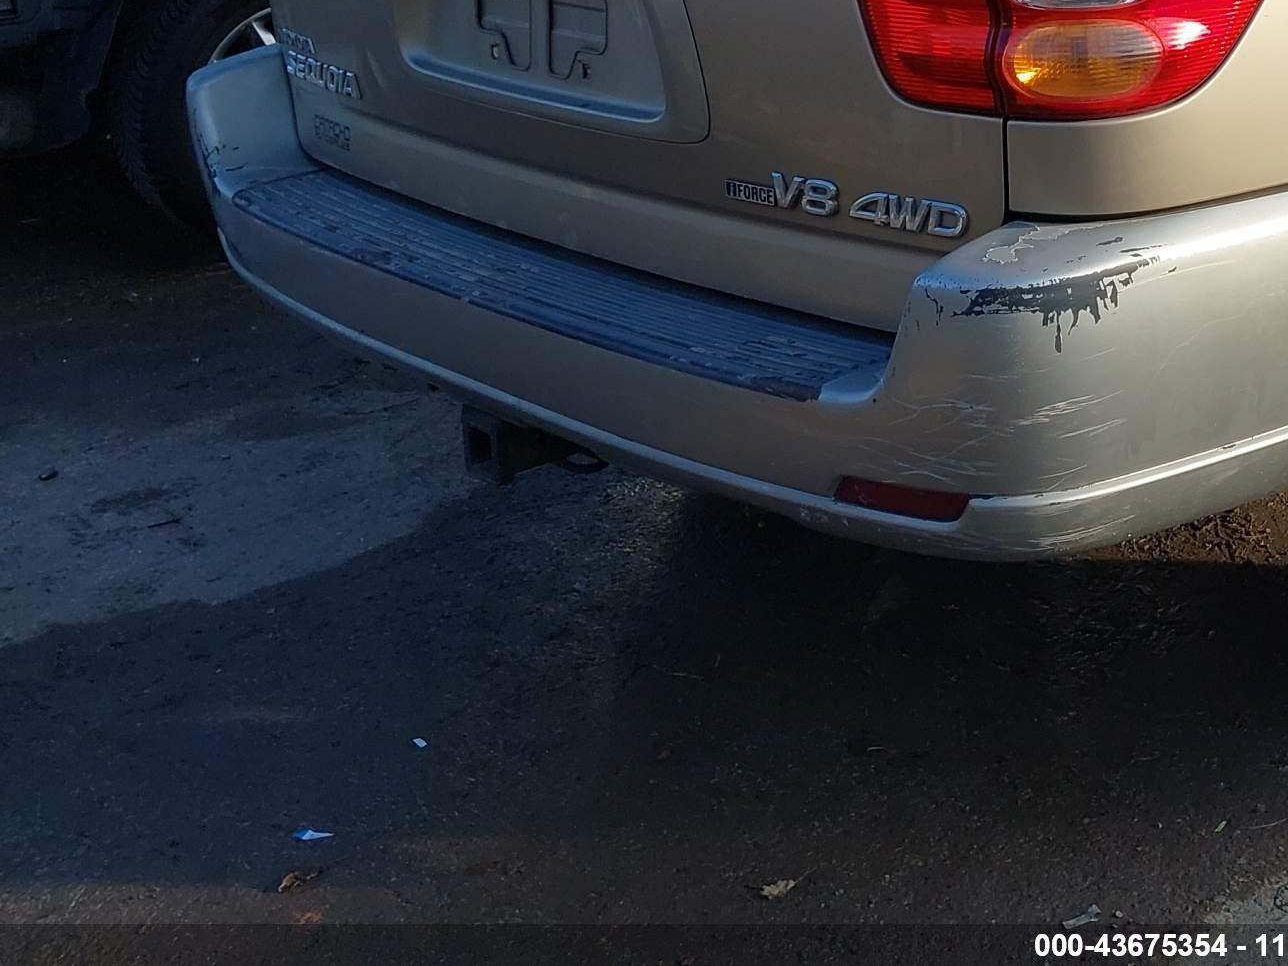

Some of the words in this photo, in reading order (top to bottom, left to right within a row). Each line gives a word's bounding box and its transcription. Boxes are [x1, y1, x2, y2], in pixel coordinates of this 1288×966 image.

[286, 50, 363, 99] SEQUOIA
[771, 170, 839, 217] V8
[849, 191, 970, 239] 4WD
